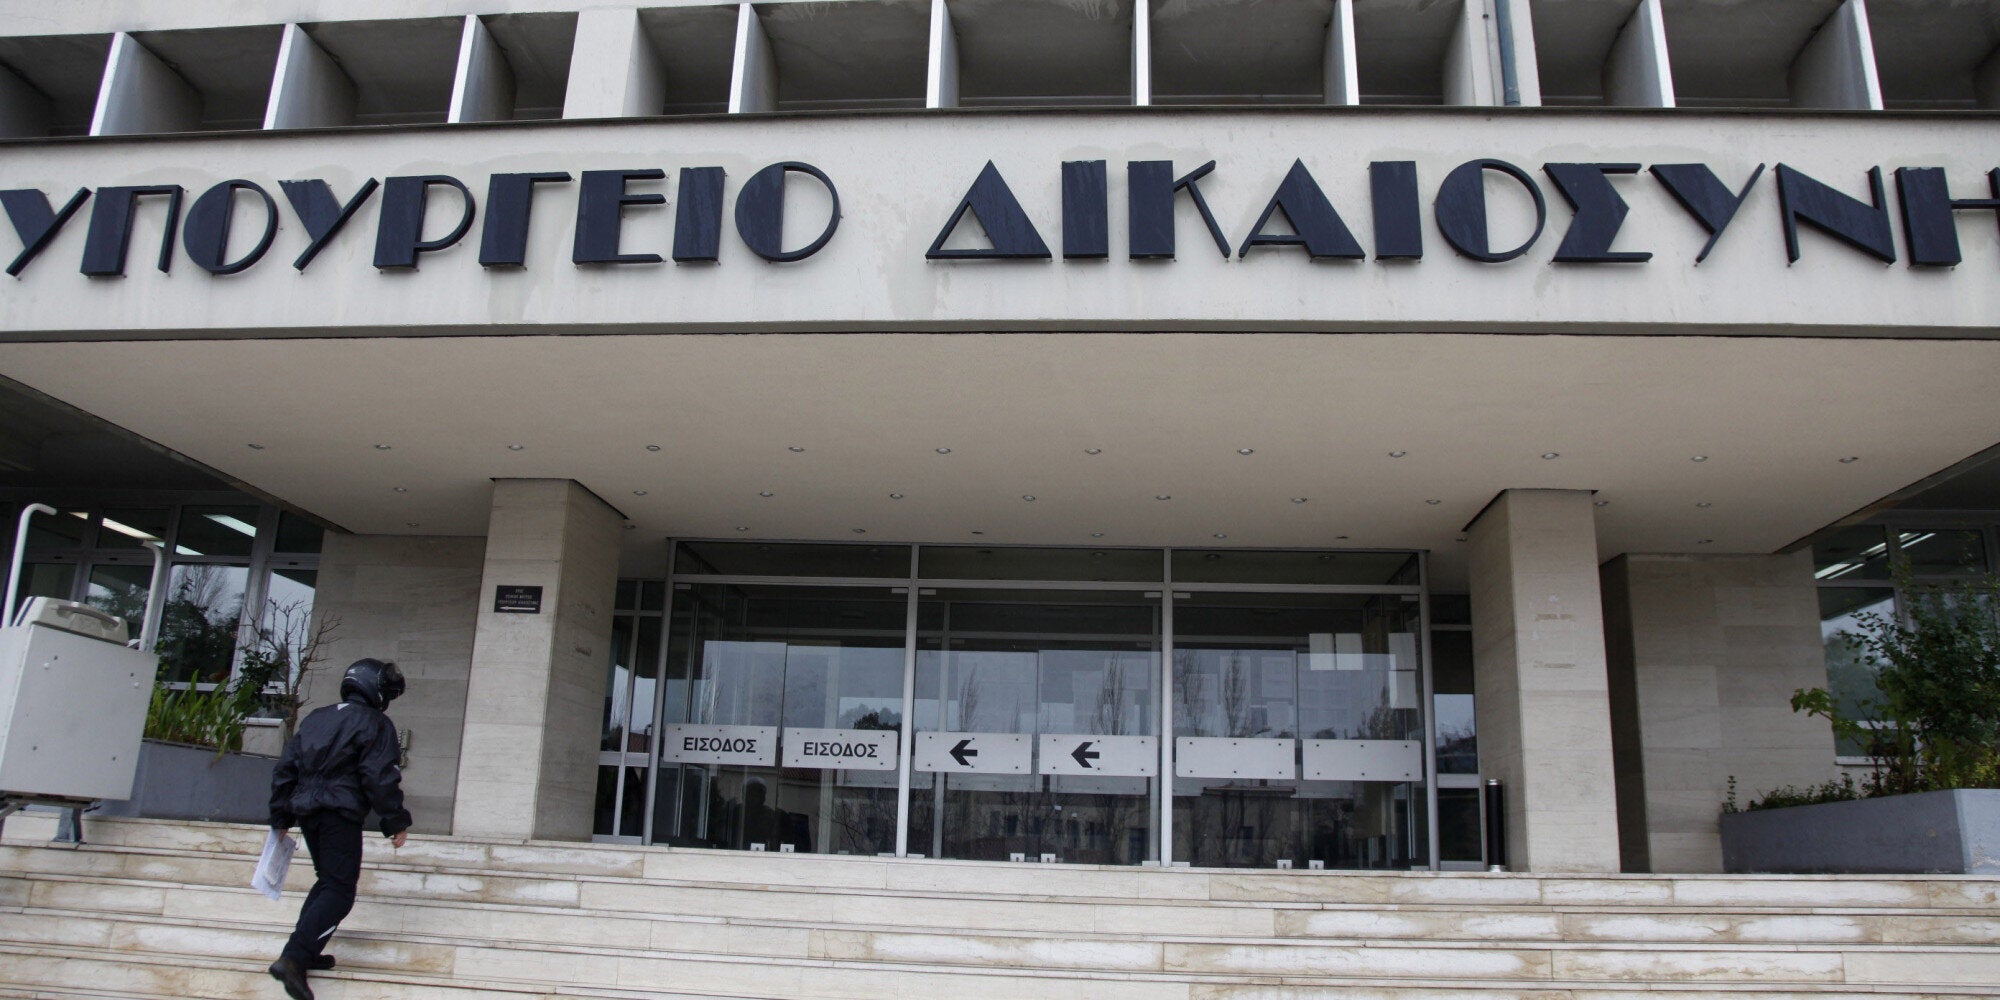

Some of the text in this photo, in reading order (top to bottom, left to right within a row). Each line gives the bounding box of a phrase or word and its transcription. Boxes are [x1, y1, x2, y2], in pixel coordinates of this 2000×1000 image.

[0, 157, 2000, 281] ΥΠΟΥΡΓΕΙΟ ΔΙΚΑΙΟΣΥΝΗ
[683, 736, 757, 754] ΕΙΣΟΔΟΣ
[803, 741, 879, 758] ΕΙΣΟΔΟΣ
